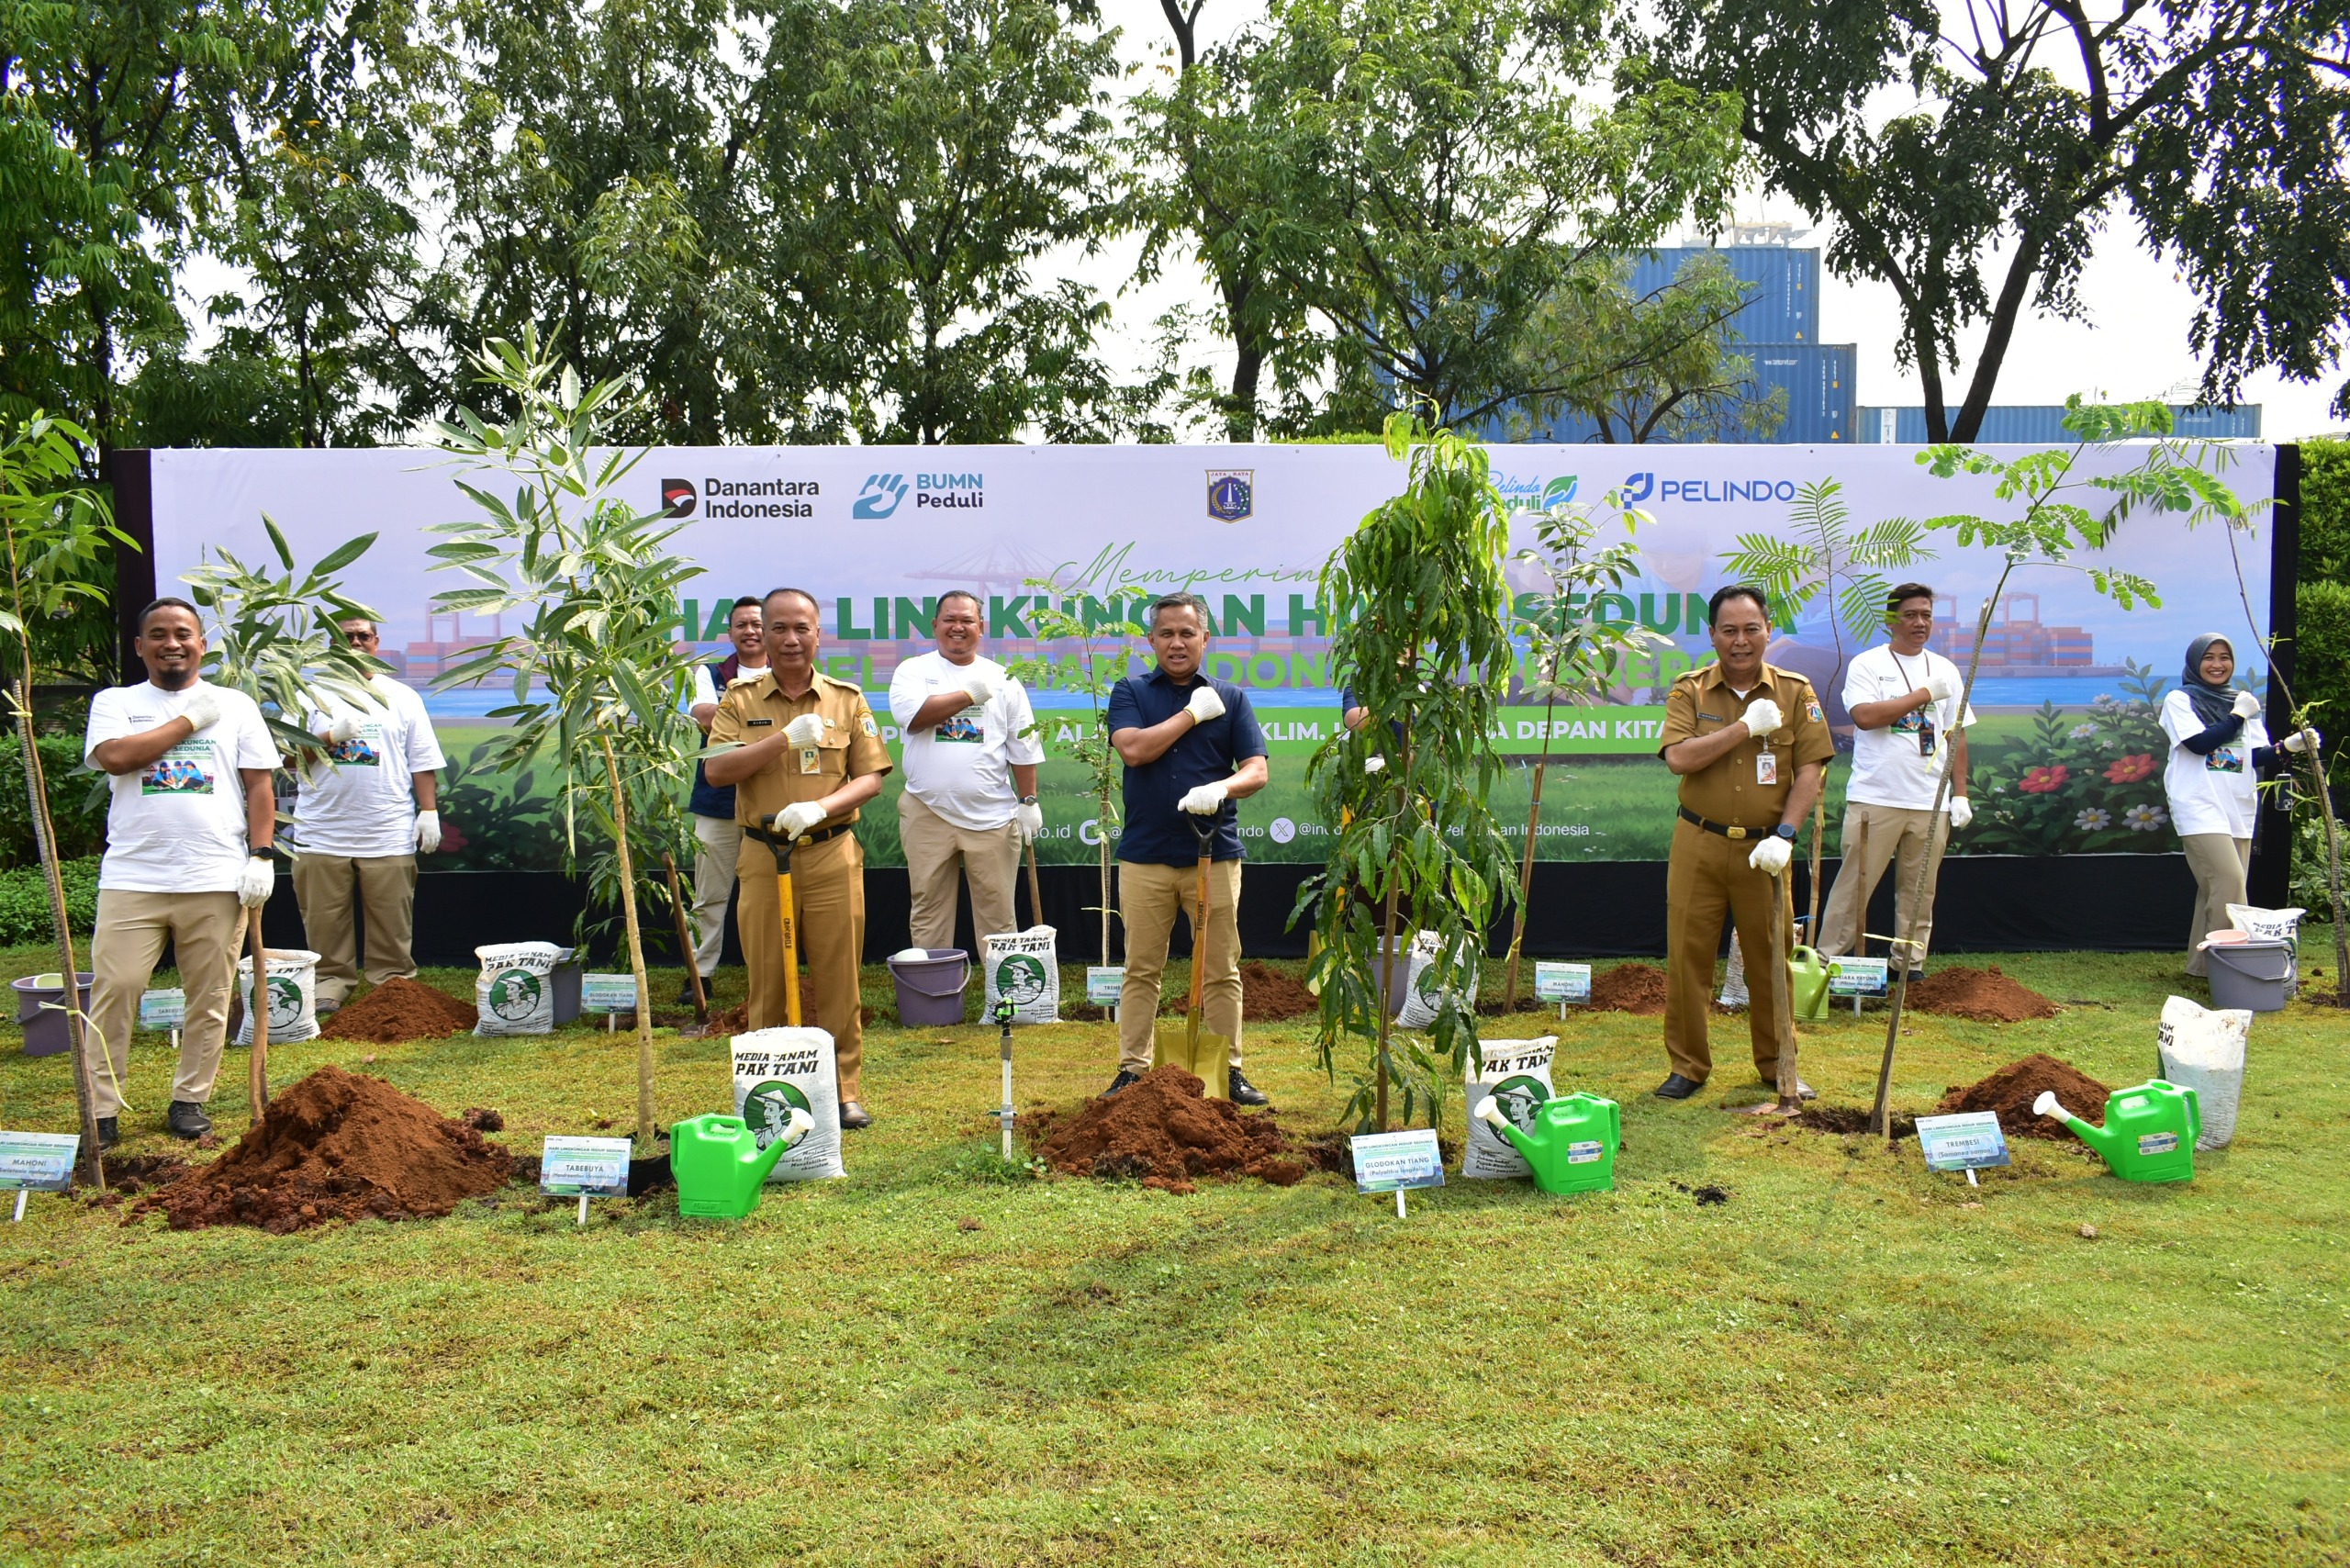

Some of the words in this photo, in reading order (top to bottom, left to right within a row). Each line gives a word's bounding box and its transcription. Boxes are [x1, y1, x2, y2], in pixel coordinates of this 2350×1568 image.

[705, 477, 820, 497] Danantara
[917, 474, 983, 489] BUMN
[1662, 480, 1795, 502] PELINDO
[917, 492, 984, 509] Peduli
[705, 499, 813, 518] Indonesia
[836, 594, 1265, 641] LINKUNGN
[1511, 592, 1798, 636] SEDUNA
[1258, 721, 1326, 741] KLIM.
[1516, 721, 1606, 739] DEPAN
[1521, 823, 1590, 836] Idonesia
[991, 943, 1017, 951] PAK
[1021, 941, 1050, 952] TANI
[518, 958, 551, 969] TANI
[2158, 1030, 2175, 1047] ANI
[734, 1052, 770, 1061] MEDIA
[735, 1063, 769, 1076] PAK
[773, 1059, 819, 1076] TANI
[1946, 1138, 1980, 1148] TREMBESI
[12, 1159, 48, 1167] MAHONI
[565, 1164, 604, 1172] TABEBUYA
[1365, 1159, 1406, 1169] GLODOKAN
[1407, 1157, 1429, 1165] TIANG
